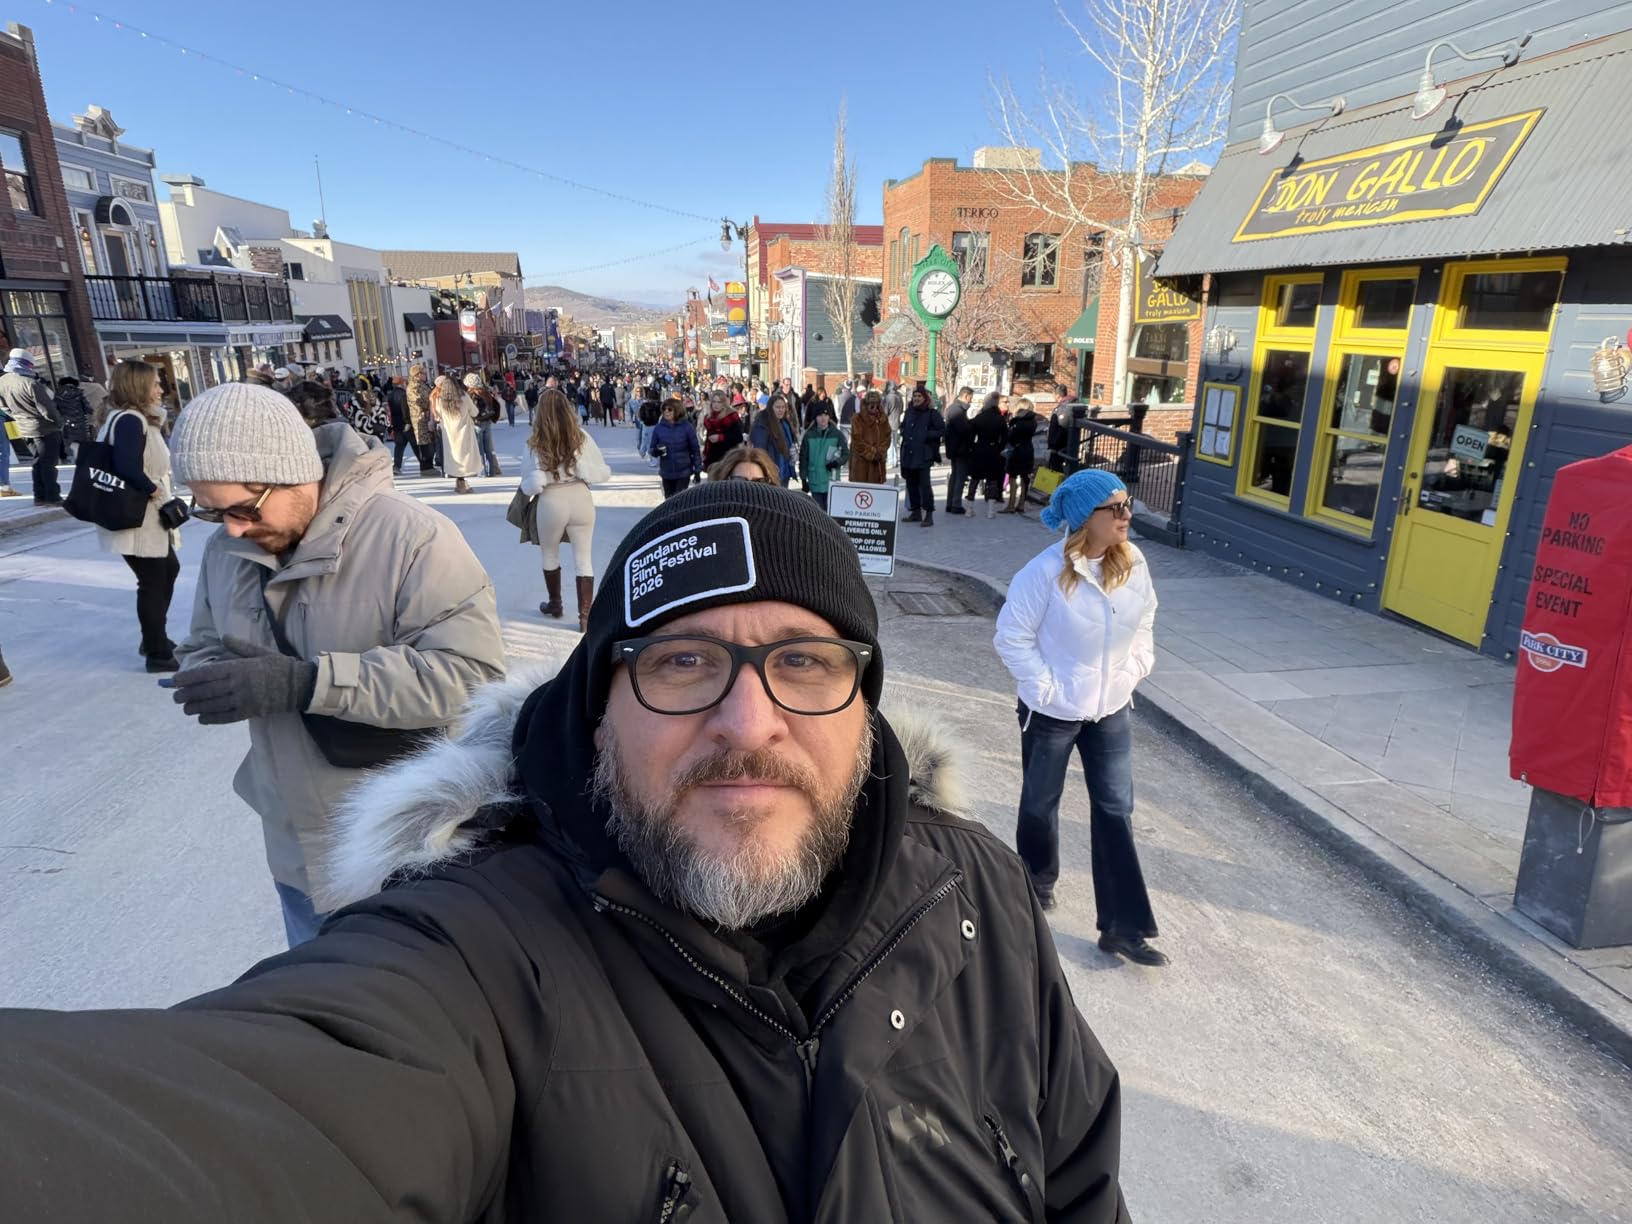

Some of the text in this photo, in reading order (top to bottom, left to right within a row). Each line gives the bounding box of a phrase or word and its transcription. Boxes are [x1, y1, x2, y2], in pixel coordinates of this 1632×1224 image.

[1267, 137, 1487, 212] DON GALLO
[957, 207, 999, 218] TERIGO
[1295, 198, 1398, 225] truly mexican
[1151, 279, 1178, 293] DON
[1145, 308, 1190, 317] truly mexican
[1147, 291, 1188, 308] GALLO
[1456, 434, 1485, 452] OPEN
[845, 520, 879, 528] PERMITTED
[1568, 511, 1590, 530] NO
[631, 535, 698, 573] Sundance
[858, 545, 887, 553] ALLOWED
[1541, 527, 1605, 556] PARKING
[631, 543, 717, 587] Film Festival
[632, 574, 664, 601] 2026
[1534, 564, 1593, 595] SPECIAL
[1535, 591, 1583, 618] EVENT
[1523, 636, 1581, 662] PARK CITY
